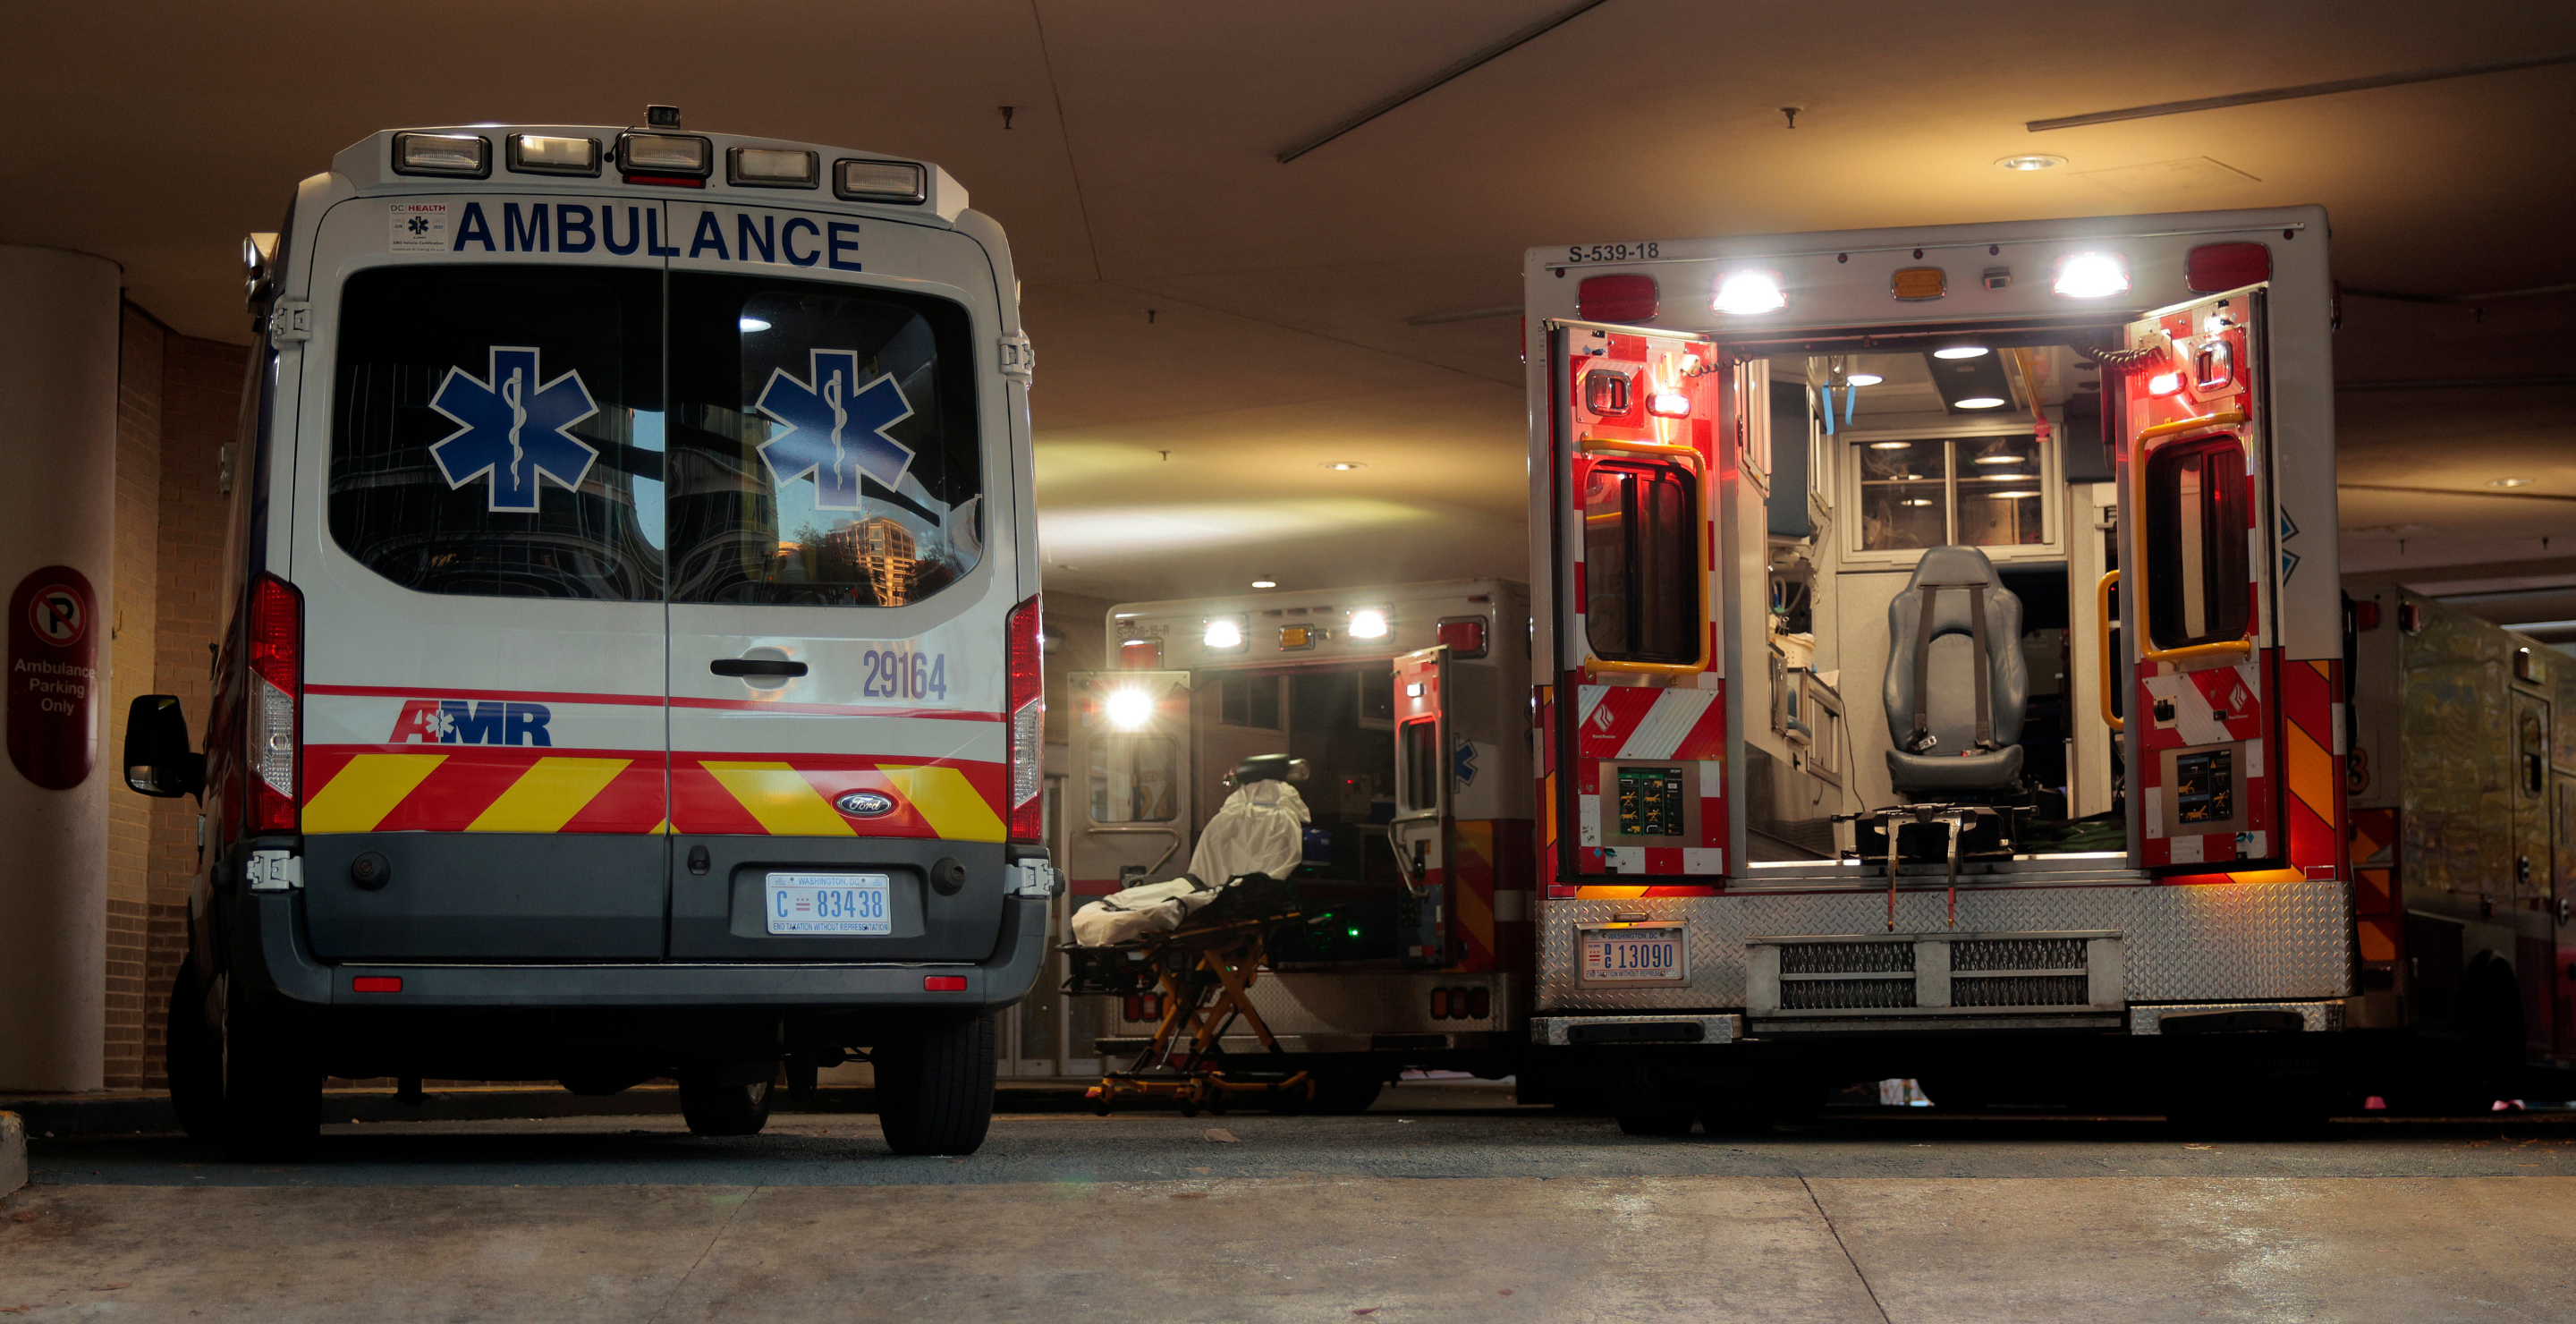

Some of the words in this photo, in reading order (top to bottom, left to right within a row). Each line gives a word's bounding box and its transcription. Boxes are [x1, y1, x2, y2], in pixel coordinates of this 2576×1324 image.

[453, 202, 862, 273] AMBULANCE
[1569, 242, 1659, 262] S-539-18
[14, 658, 97, 680] Ambulance
[863, 649, 946, 701] 29164
[29, 678, 85, 700] Parking
[41, 697, 75, 717] Only
[388, 700, 552, 746] AMR
[849, 796, 881, 811] Ford
[798, 877, 849, 887] WASHINGTON,
[850, 878, 860, 887] DC
[776, 890, 788, 918] C
[817, 890, 883, 918] 83438
[774, 922, 785, 930] END
[785, 922, 813, 931] TAXATION
[813, 922, 840, 931] WITHOUT
[840, 922, 888, 931] REPRESENTATION
[1607, 932, 1648, 940] WASHINGTON,
[1618, 944, 1673, 969] 13090
[1586, 970, 1596, 978] END
[1596, 970, 1618, 978] TATION
[1618, 970, 1640, 978] WITHOUT
[1640, 969, 1680, 977] REPRESETATION
